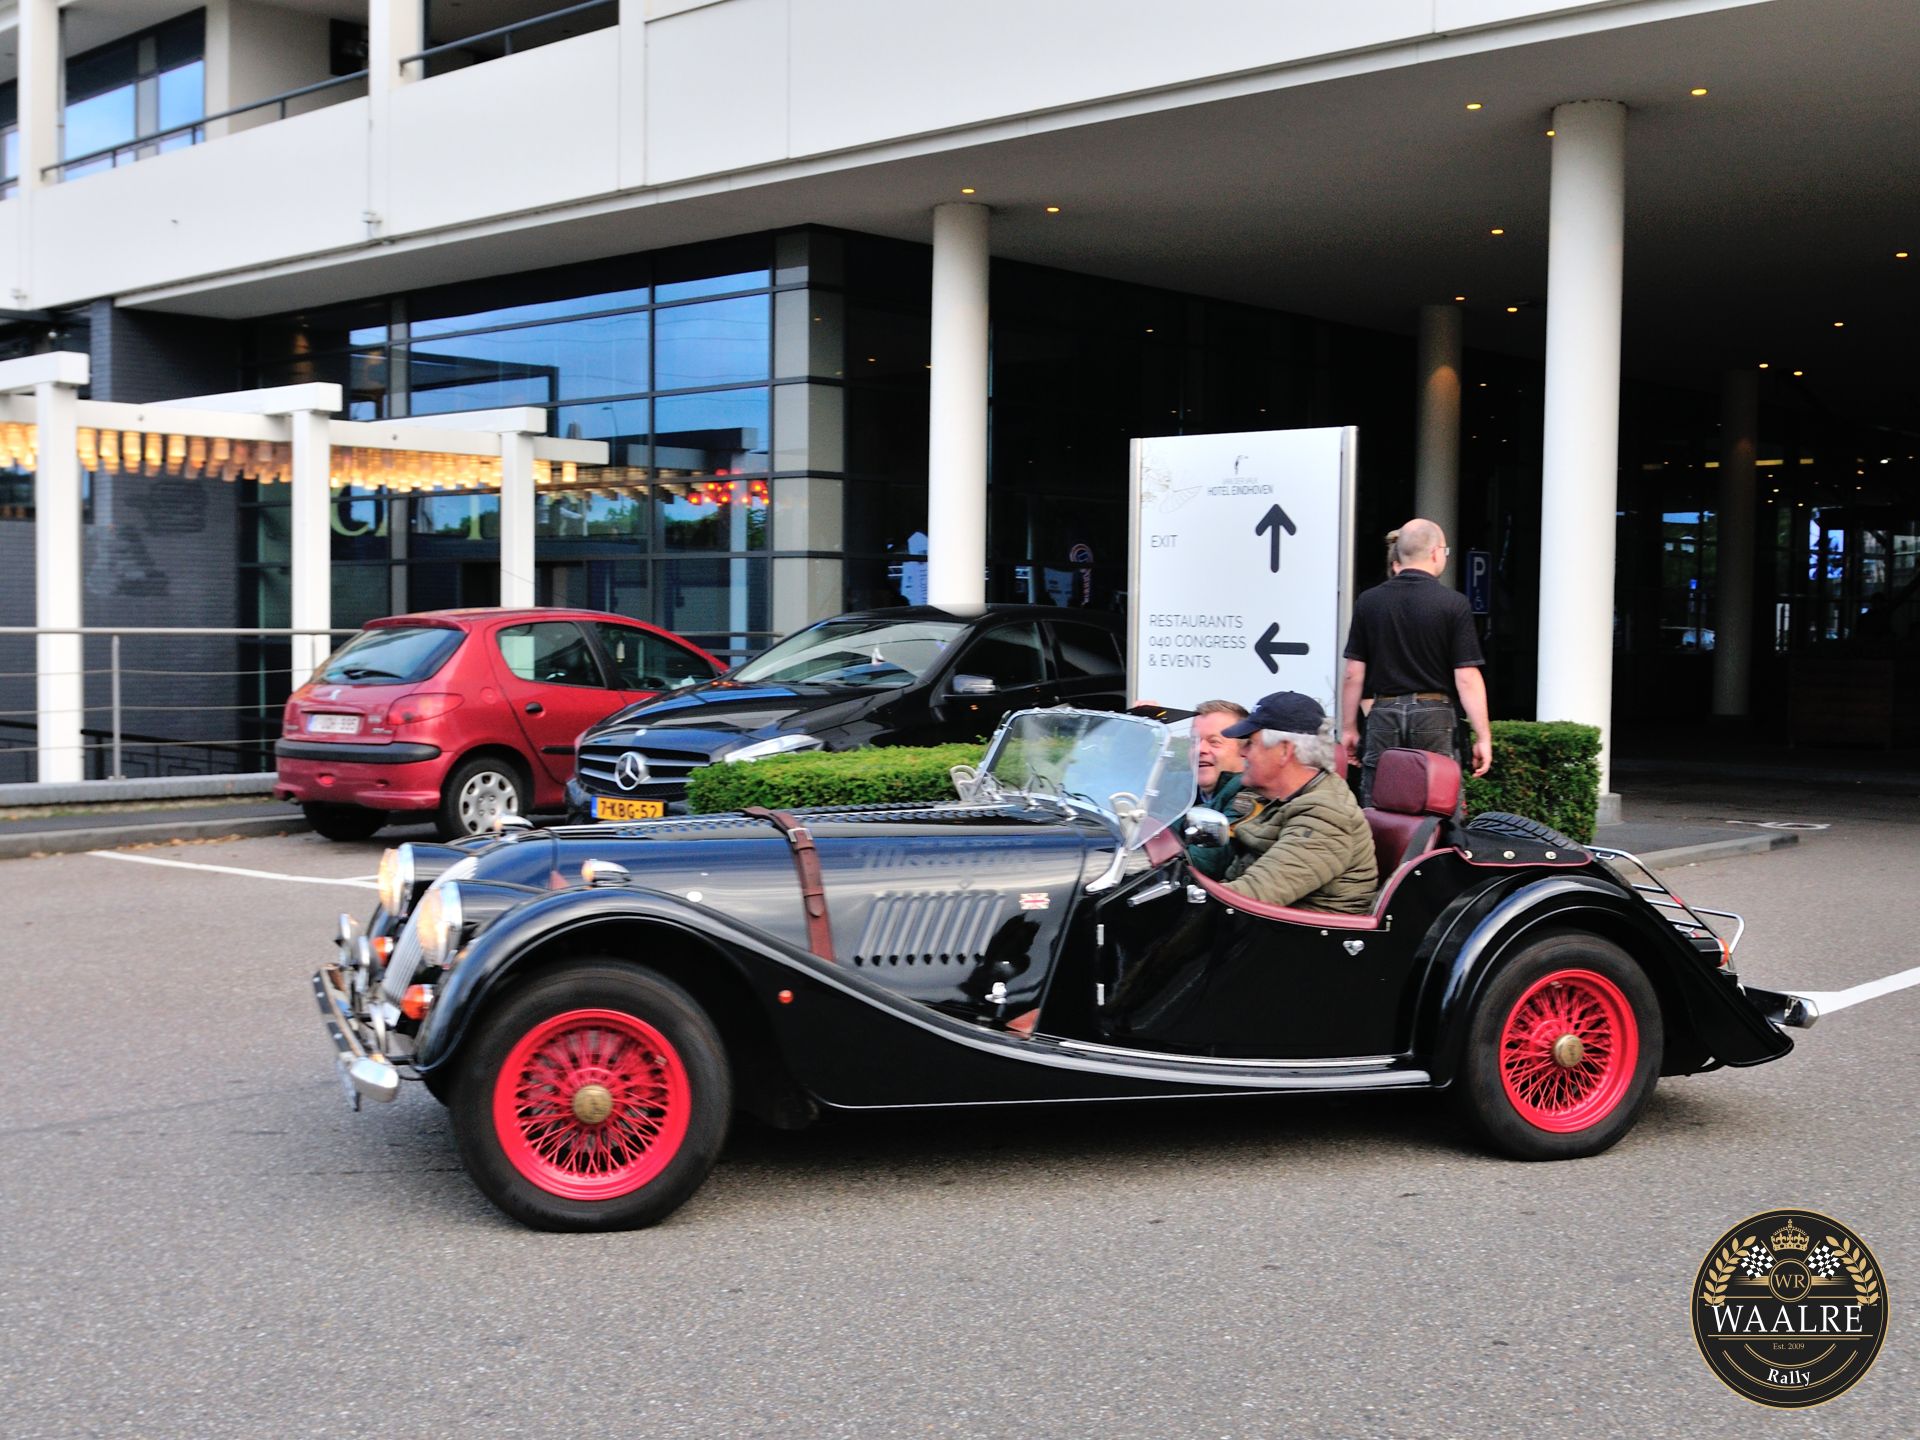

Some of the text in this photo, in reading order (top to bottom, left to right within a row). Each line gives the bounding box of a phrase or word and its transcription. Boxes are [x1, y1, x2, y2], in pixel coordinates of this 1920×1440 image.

[1151, 534, 1178, 548] EXIT
[1473, 556, 1486, 588] P
[1149, 614, 1244, 629] RESTAURANTS
[1148, 634, 1247, 649] 040 CONGRESS
[1148, 653, 1212, 669] & EVENTS
